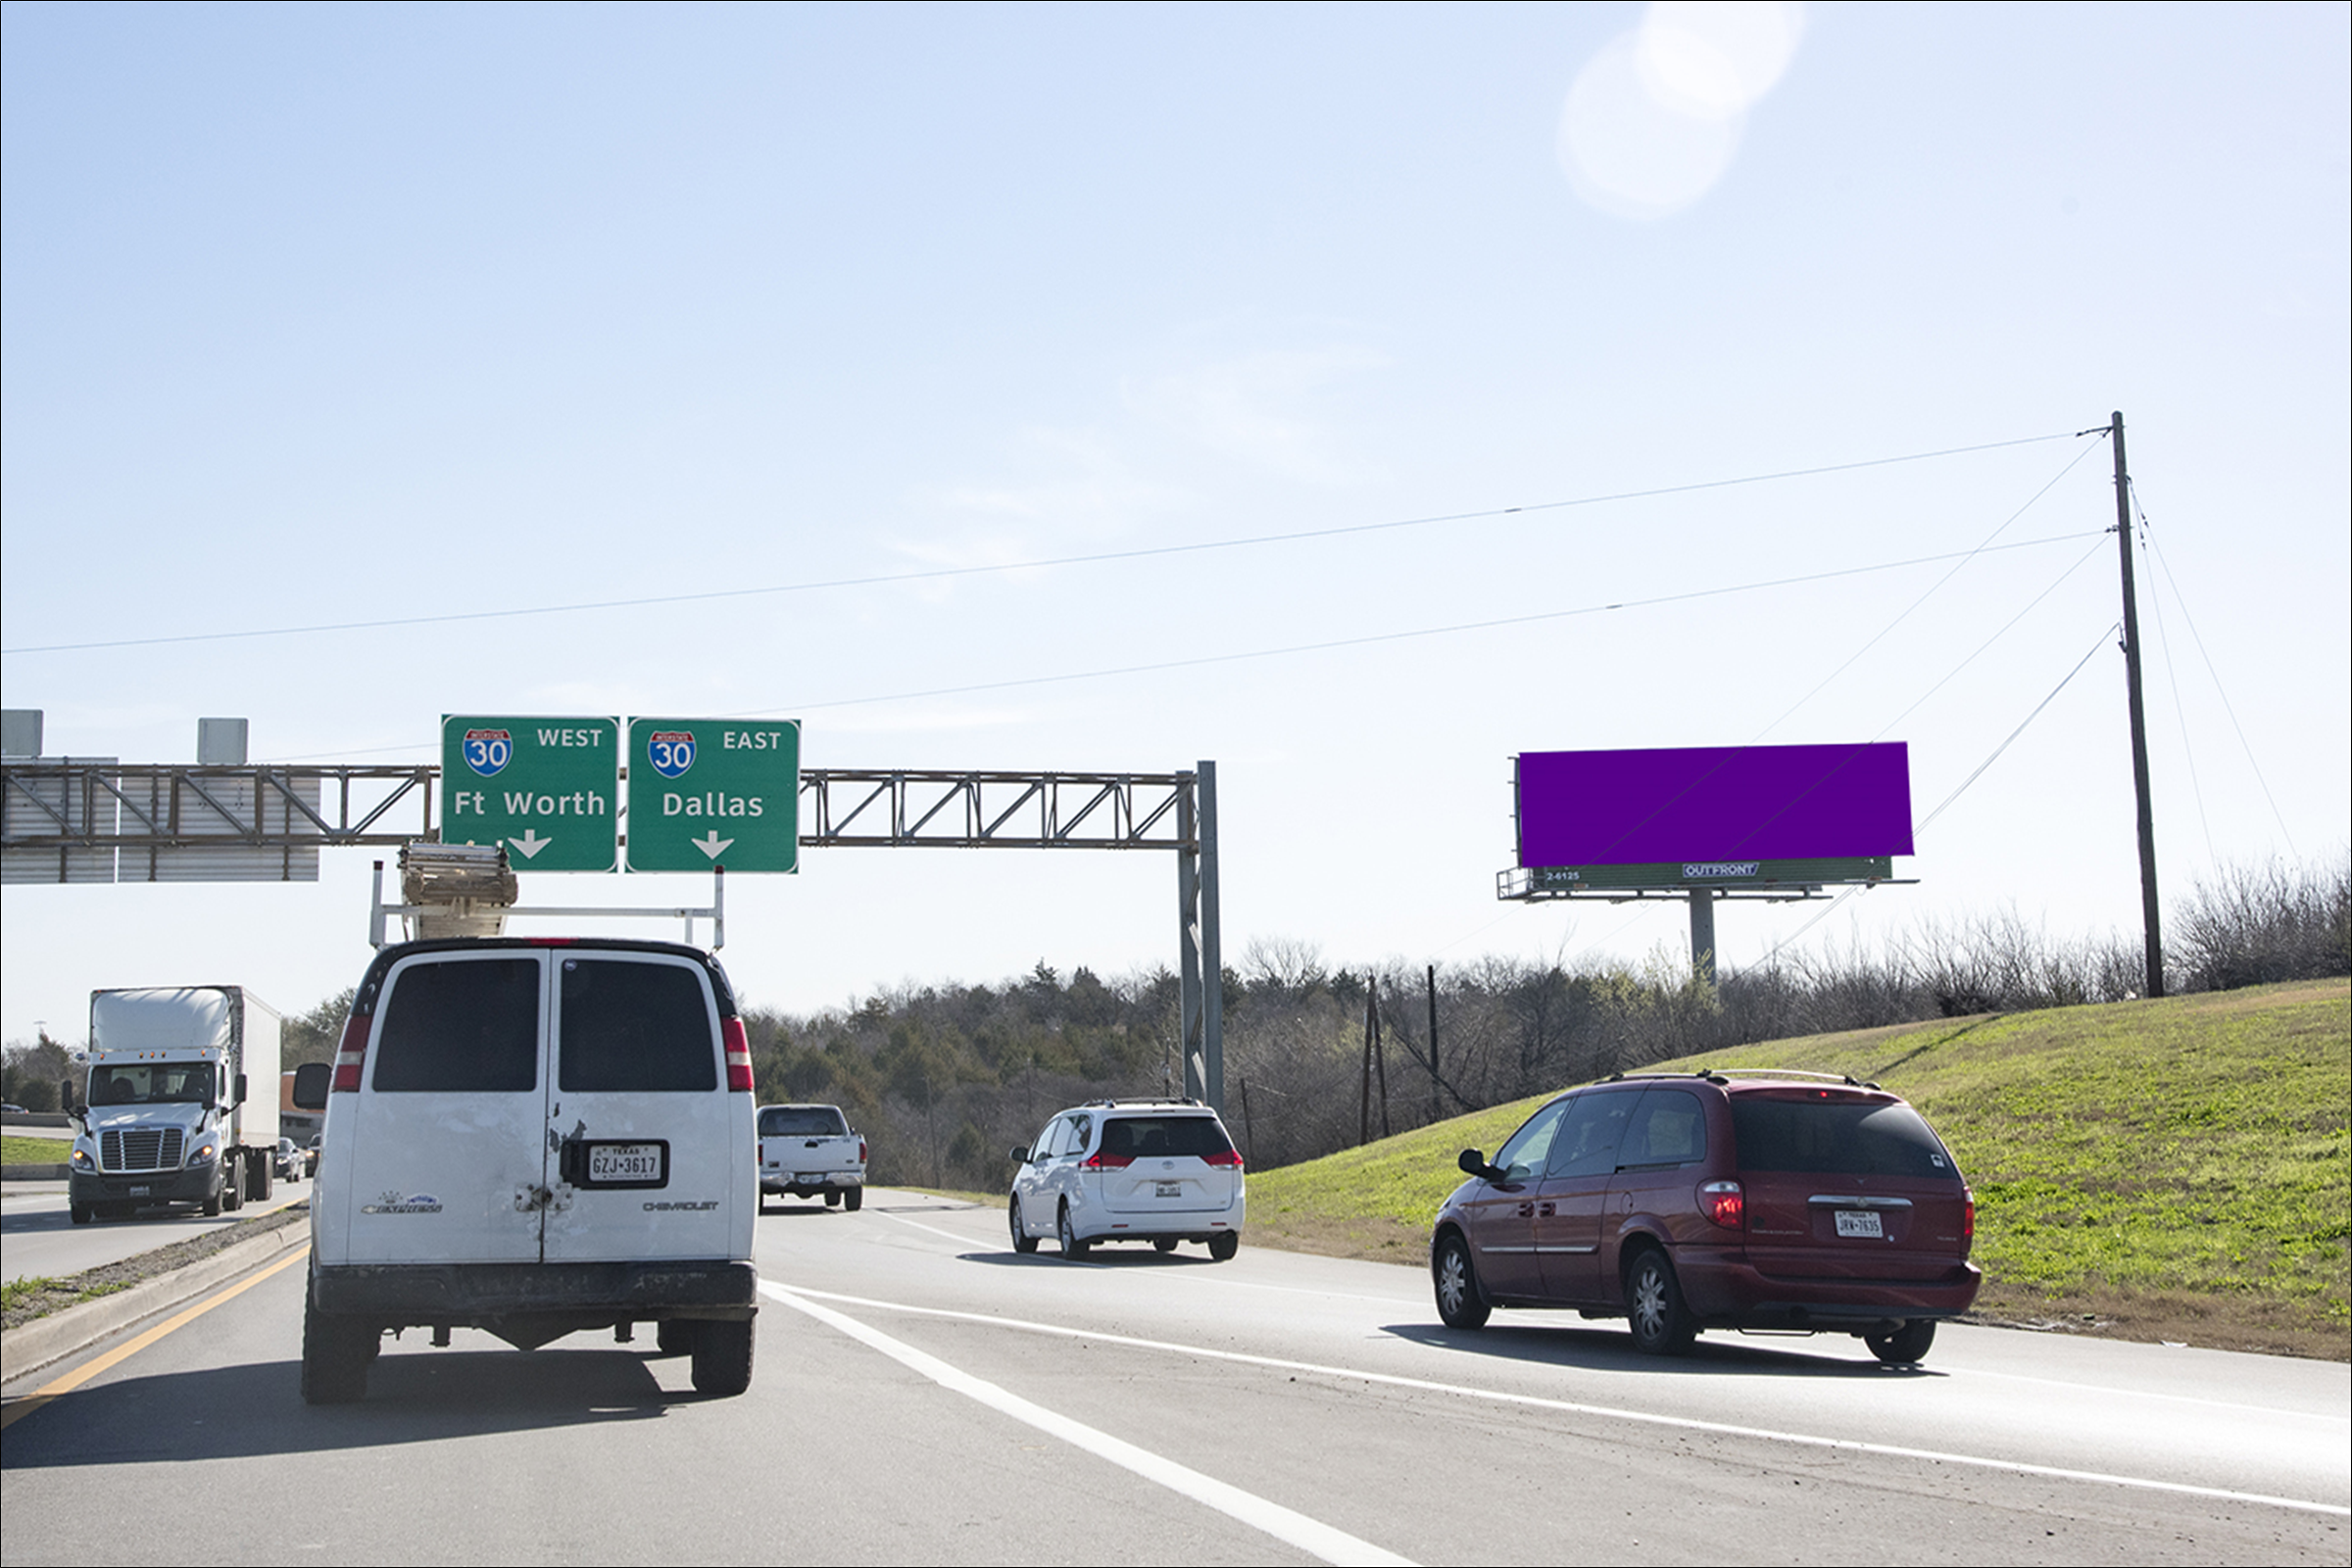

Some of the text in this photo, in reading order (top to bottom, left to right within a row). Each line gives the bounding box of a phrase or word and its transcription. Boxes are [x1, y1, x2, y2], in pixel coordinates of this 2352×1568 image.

[537, 728, 603, 747] WEST
[723, 731, 781, 750] EAST
[470, 741, 507, 766] 30
[655, 743, 691, 768] 30
[455, 790, 605, 815] Ft Worth
[662, 792, 763, 816] Dallas
[1546, 871, 1580, 881] 2-6125
[1686, 863, 1755, 876] OUTFRONT
[643, 1201, 719, 1211] CHEVROLET
